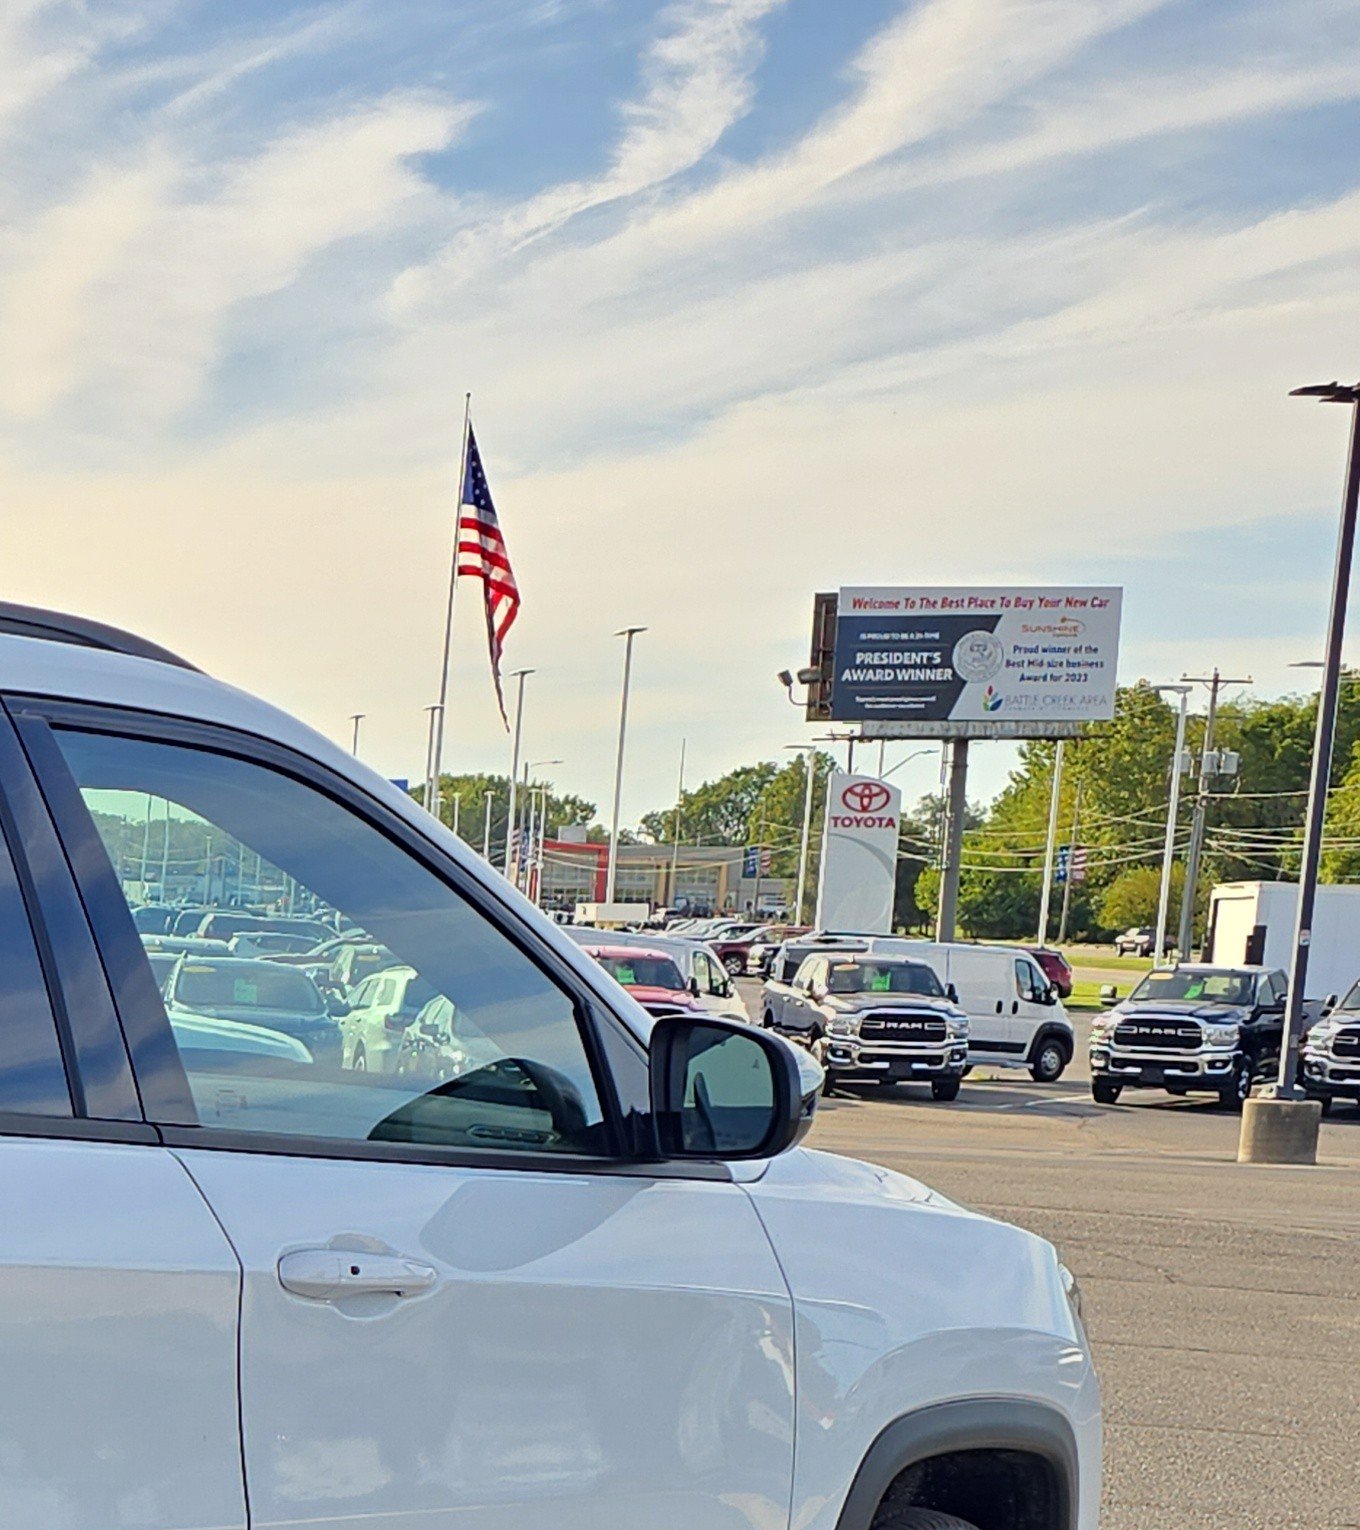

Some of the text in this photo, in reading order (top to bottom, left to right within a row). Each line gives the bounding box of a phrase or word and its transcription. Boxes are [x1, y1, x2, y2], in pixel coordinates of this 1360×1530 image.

[852, 596, 1110, 610] Welcome To The Best Place To Buy Your New Car
[1013, 644, 1039, 654] Proud
[1073, 644, 1083, 654] of
[1084, 644, 1098, 654] the
[855, 652, 941, 665] PRESIDENT'S
[841, 668, 953, 681] AWARD WINNER
[1019, 673, 1048, 683] Award
[1050, 673, 1063, 683] for
[831, 816, 896, 829] TOYOTA
